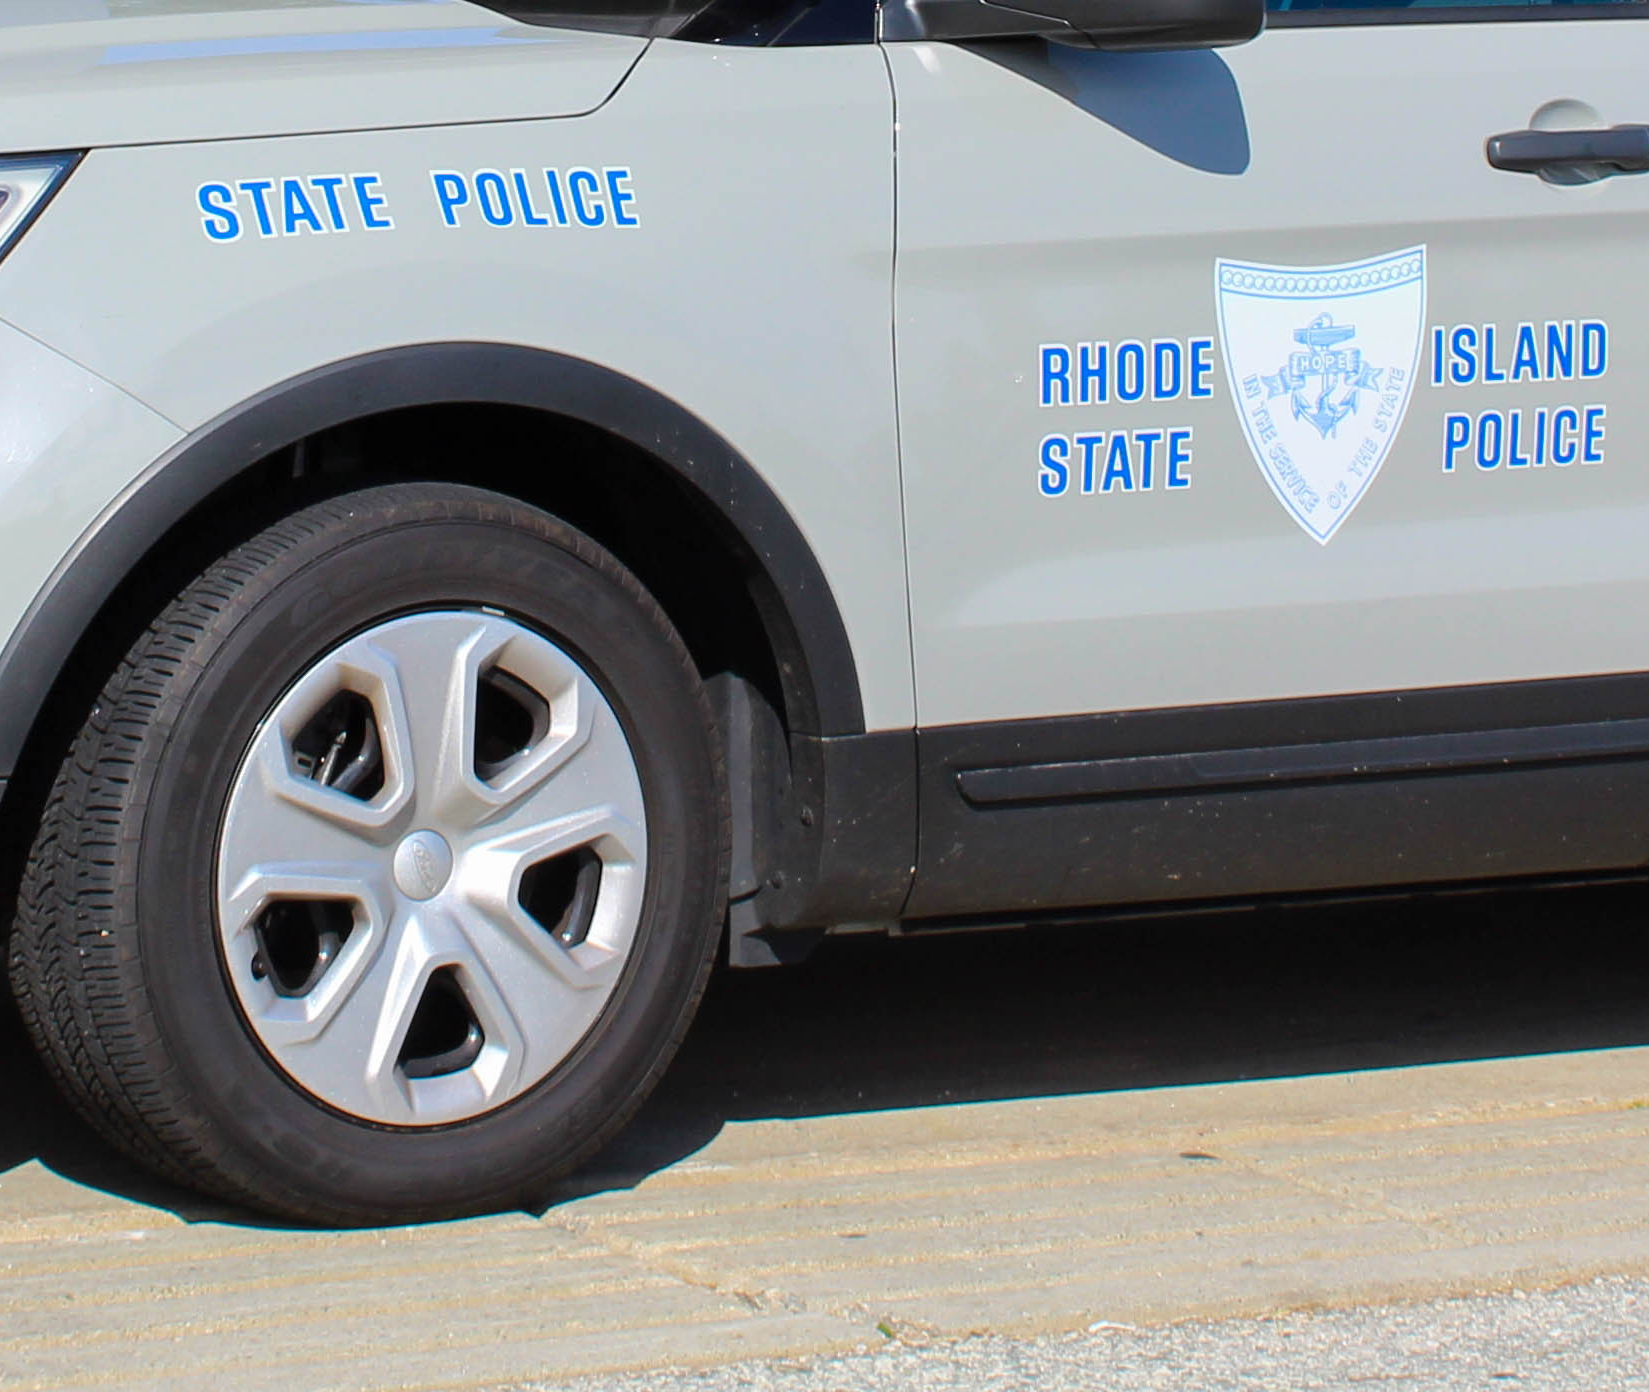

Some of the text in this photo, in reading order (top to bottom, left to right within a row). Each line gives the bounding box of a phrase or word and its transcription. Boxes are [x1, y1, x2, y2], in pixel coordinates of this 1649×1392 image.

[198, 168, 639, 242] STATE POLICE
[1040, 320, 1607, 405] RHODE ISLAND
[1301, 355, 1348, 369] HOPE
[1040, 406, 1607, 496] STATE POLICE
[1242, 366, 1405, 513] IN THE SERVICE OF THE STATE
